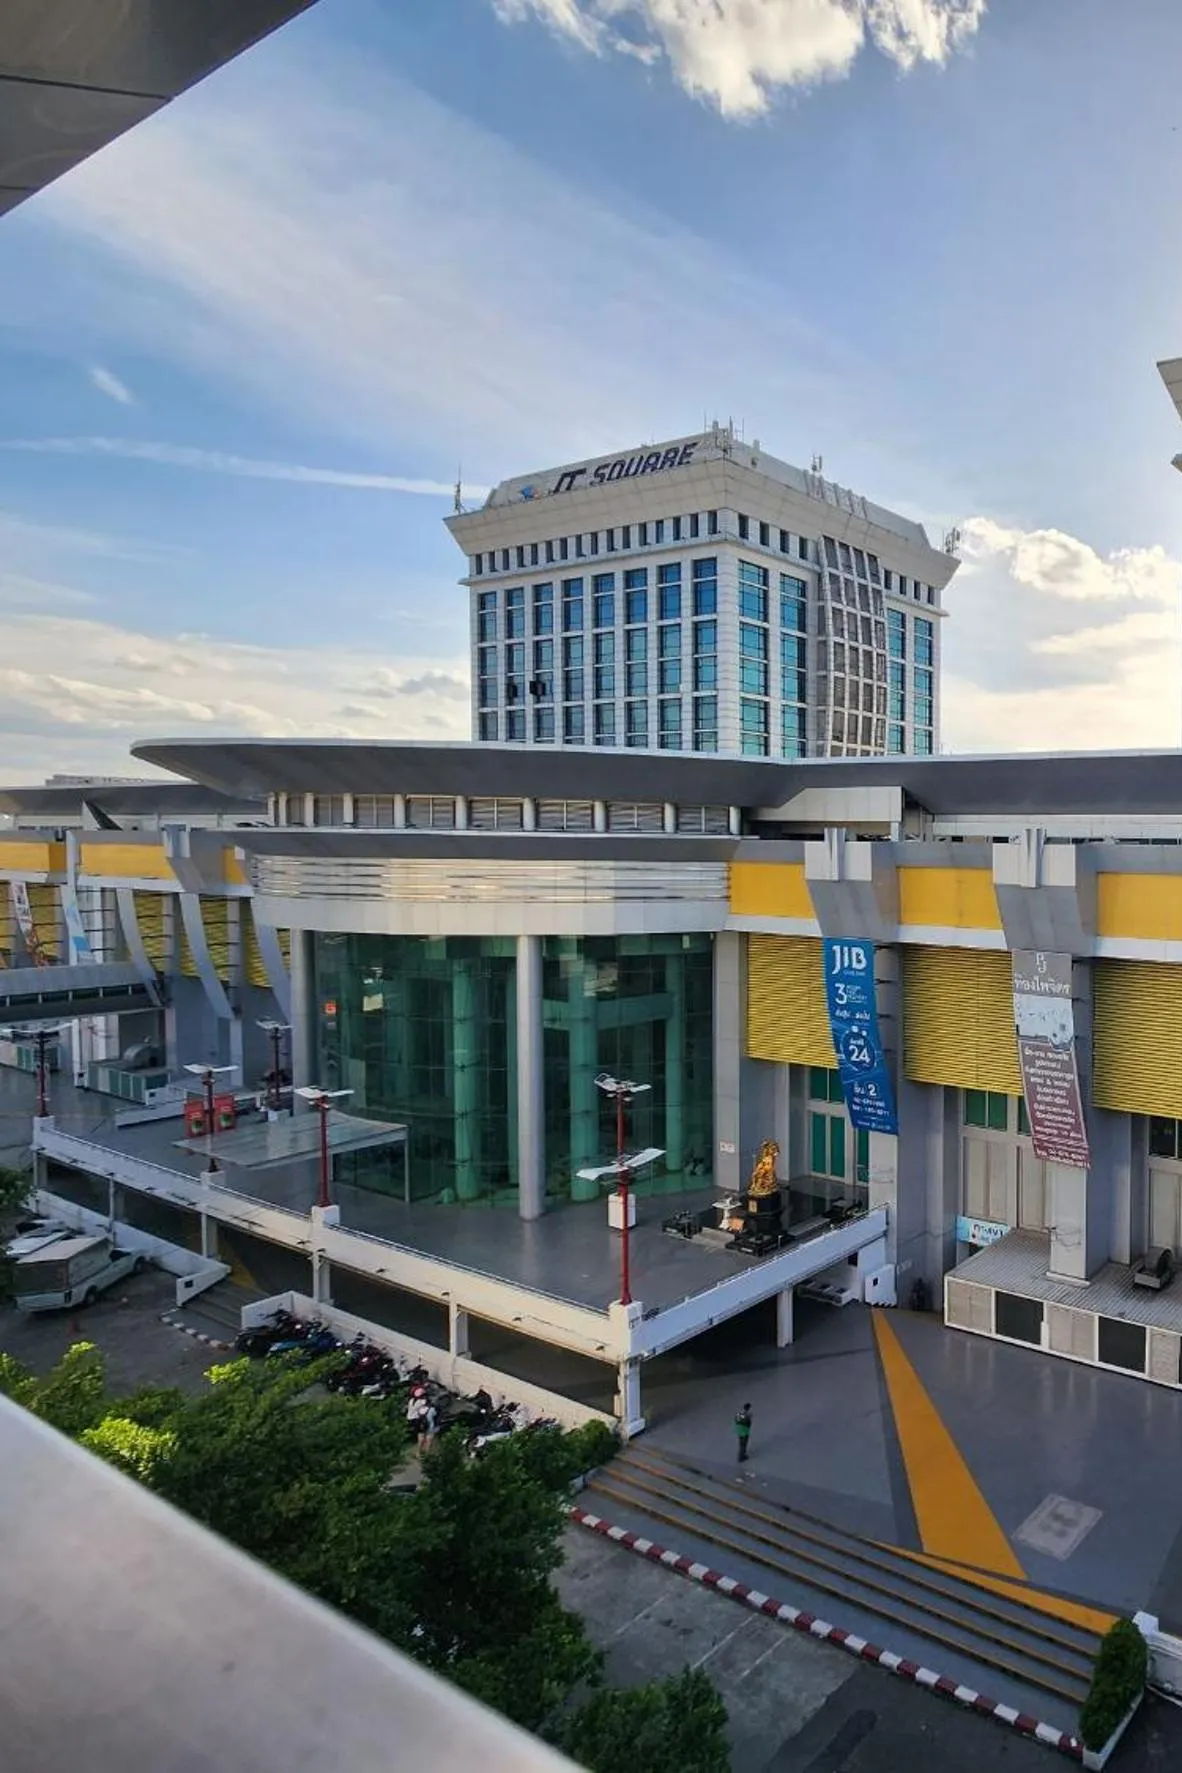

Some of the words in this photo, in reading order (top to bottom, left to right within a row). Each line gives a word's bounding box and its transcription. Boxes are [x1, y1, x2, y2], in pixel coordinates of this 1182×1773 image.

[552, 468, 587, 494] IT
[589, 442, 698, 486] SQUARE
[832, 945, 867, 974] JIB
[834, 983, 848, 1005] 3
[848, 1046, 870, 1063] 24
[867, 1084, 877, 1096] 2
